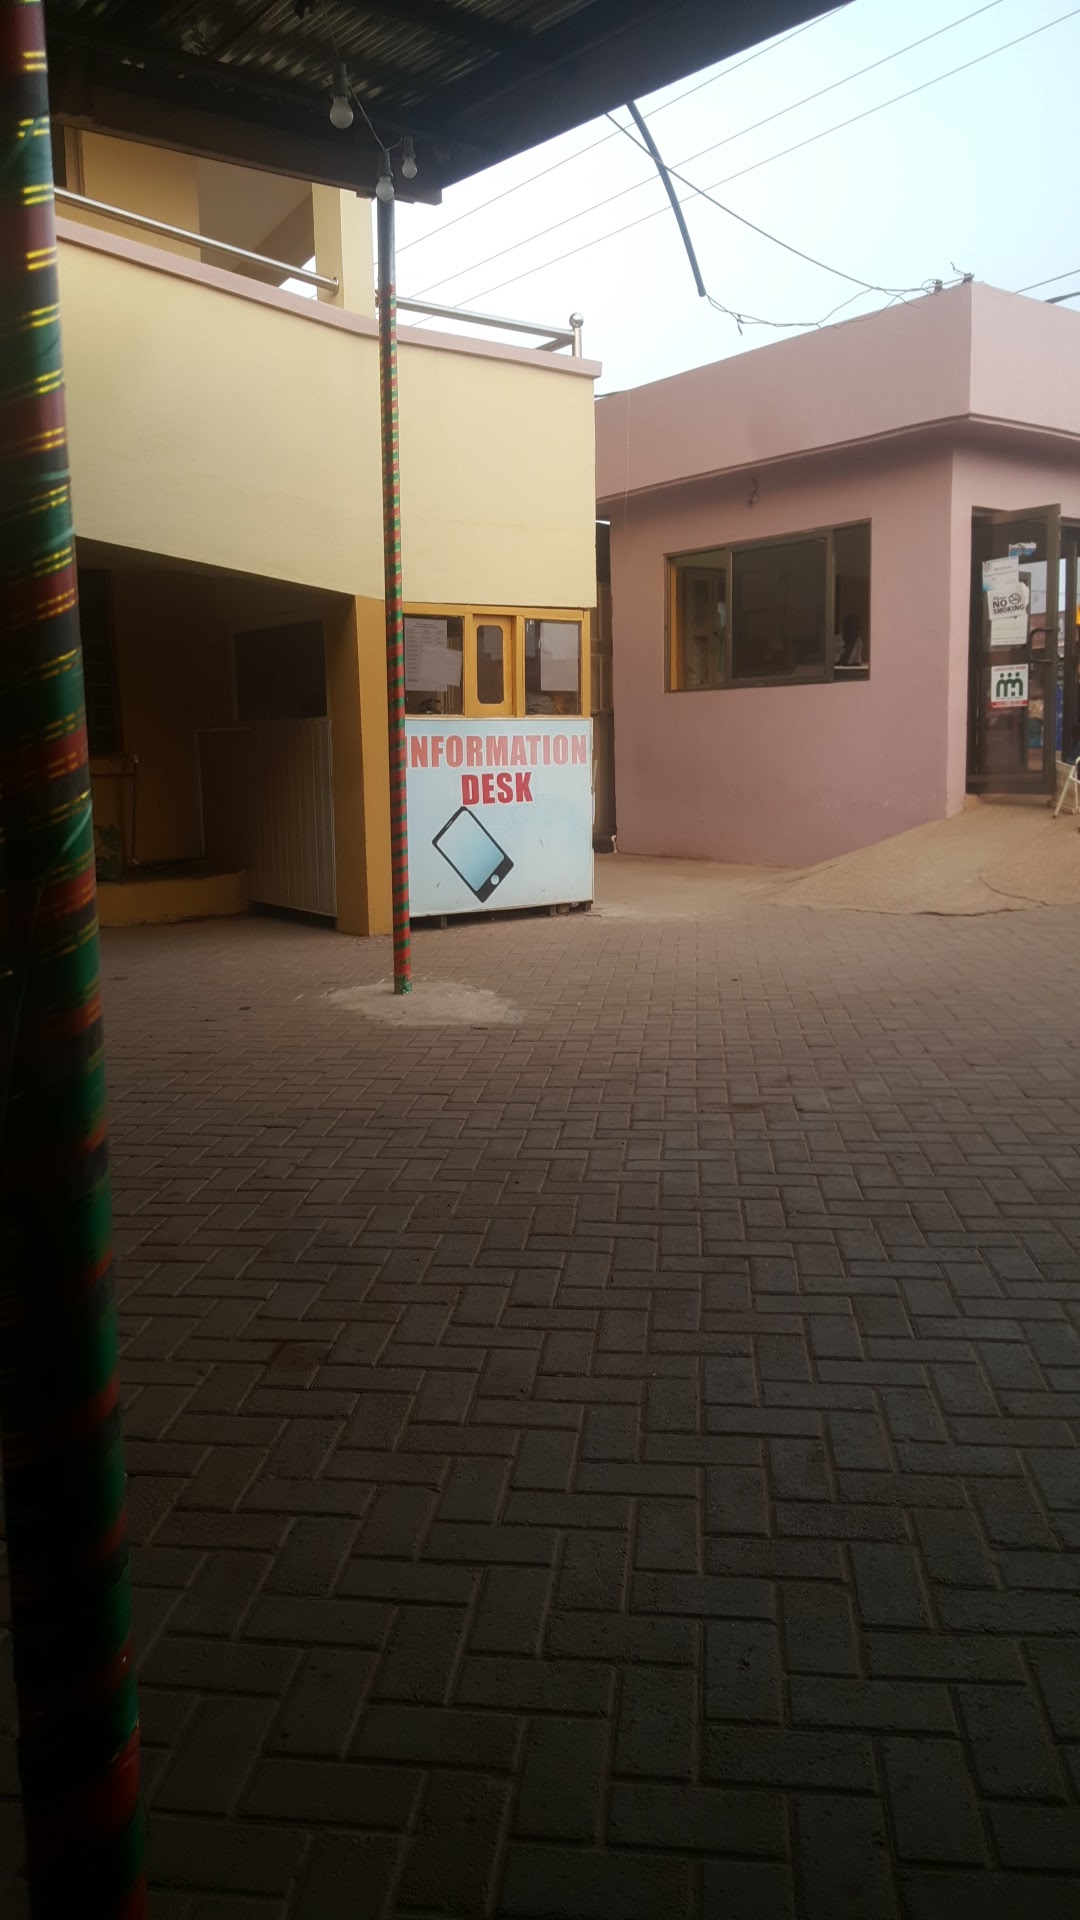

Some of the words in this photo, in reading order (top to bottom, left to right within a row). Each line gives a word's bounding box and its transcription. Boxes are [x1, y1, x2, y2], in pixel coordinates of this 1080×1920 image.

[993, 599, 1007, 608] NO
[993, 604, 1025, 614] SMOKING
[461, 772, 533, 805] DESK
